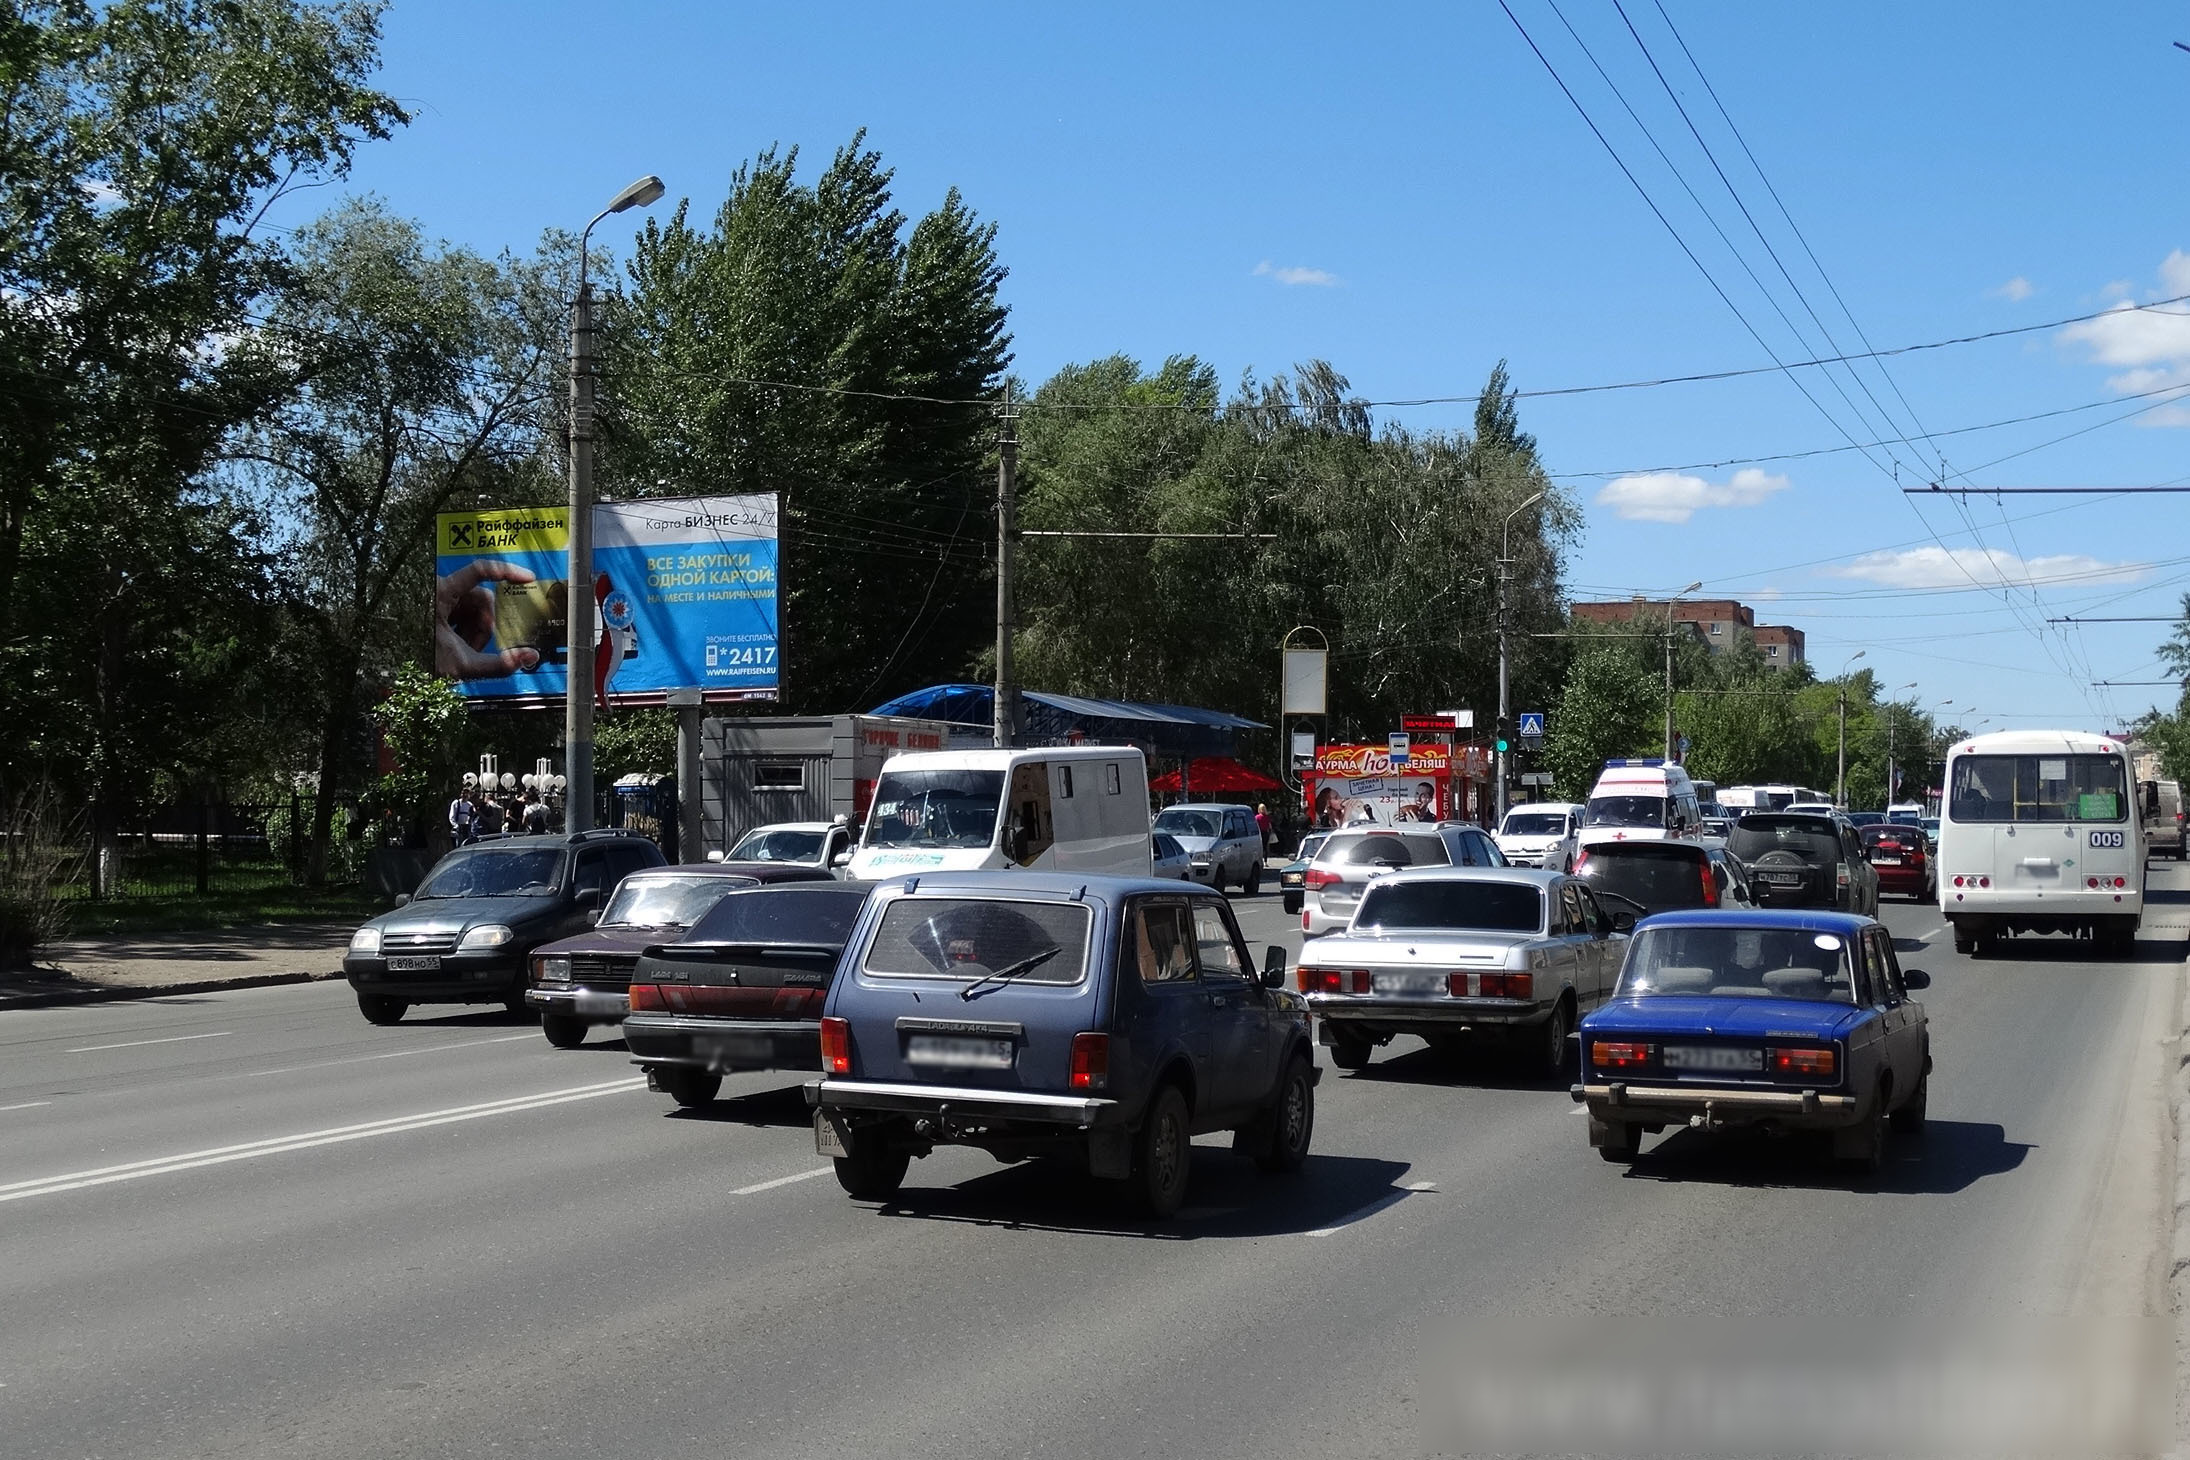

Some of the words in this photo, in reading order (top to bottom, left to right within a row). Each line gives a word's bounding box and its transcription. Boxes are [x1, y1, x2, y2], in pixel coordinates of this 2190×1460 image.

[477, 518, 563, 533] Райффайзен
[646, 518, 681, 532] Карта
[685, 514, 738, 528] БИЗНЕС
[743, 511, 775, 526] 24/7
[477, 534, 518, 548] БАНК
[647, 557, 673, 571] ВСЕ
[677, 553, 751, 570] ЗАКУПКИ
[647, 568, 705, 588] ОДНОЙ
[710, 566, 775, 584] КАРТОЙ:
[647, 595, 660, 604] НА
[664, 592, 694, 602] МЕСТЕ
[696, 592, 705, 601] И
[707, 589, 775, 601] НАЛИЧНЫМИ
[706, 635, 737, 644] ЗВОНИТЕ
[737, 633, 777, 643] БЕСПЛАТНО
[705, 667, 777, 677] WWW.RAIFFEISEN.RU
[1315, 760, 1359, 770] АУРМА
[2091, 832, 2122, 848] 009
